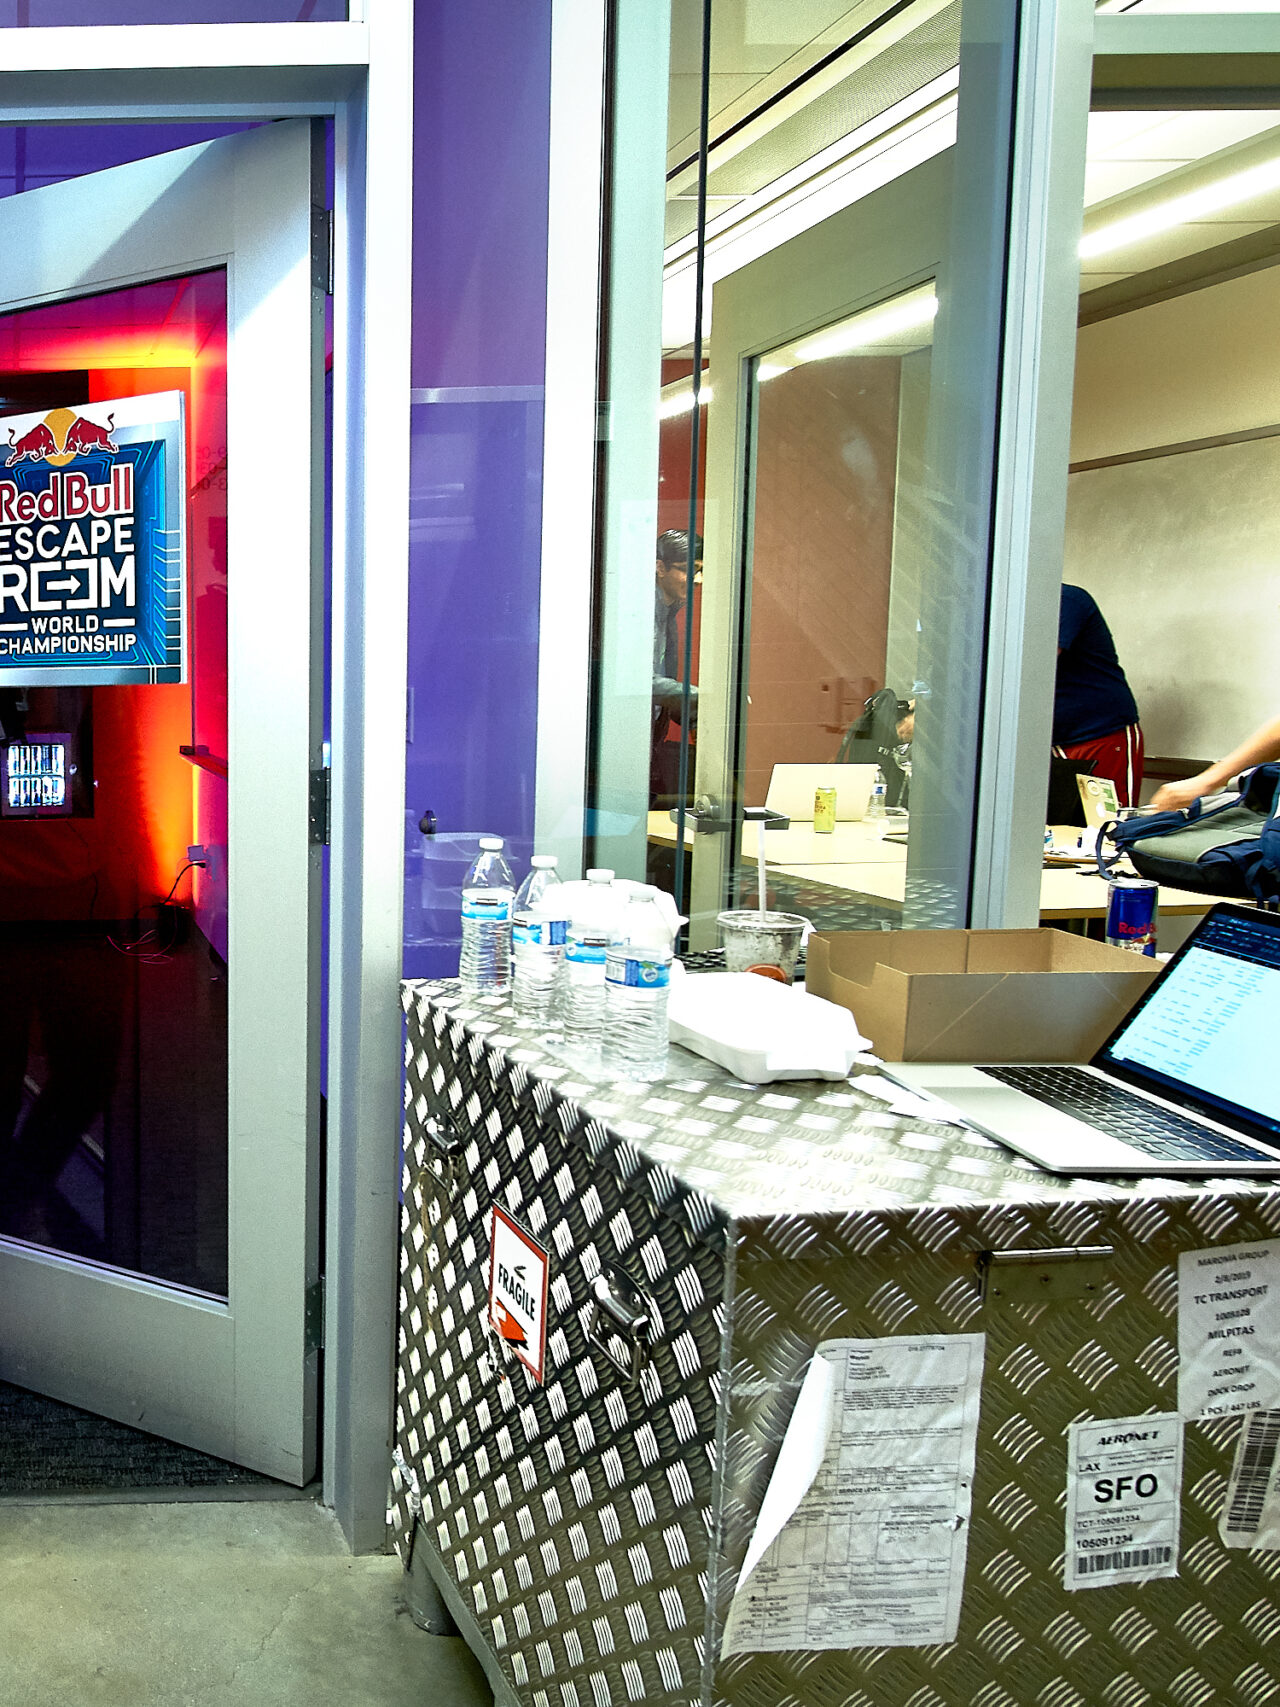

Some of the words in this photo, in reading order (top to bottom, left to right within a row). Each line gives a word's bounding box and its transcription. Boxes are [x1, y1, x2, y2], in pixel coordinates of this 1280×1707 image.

[64, 462, 134, 520] Bull
[31, 615, 99, 635] WORLD
[1118, 922, 1147, 935] Red
[1238, 1249, 1270, 1261] GROUP
[498, 1263, 535, 1321] FRAGILE
[1194, 1294, 1207, 1305] TC
[1208, 1285, 1269, 1303] TRANSPORT
[1207, 1325, 1256, 1340] MILPITAS
[1212, 1364, 1251, 1377] AERONET
[1230, 1382, 1256, 1393] DROP
[1097, 1430, 1160, 1446] AERONET
[1079, 1462, 1101, 1473] LAX
[1094, 1473, 1159, 1504] SFO
